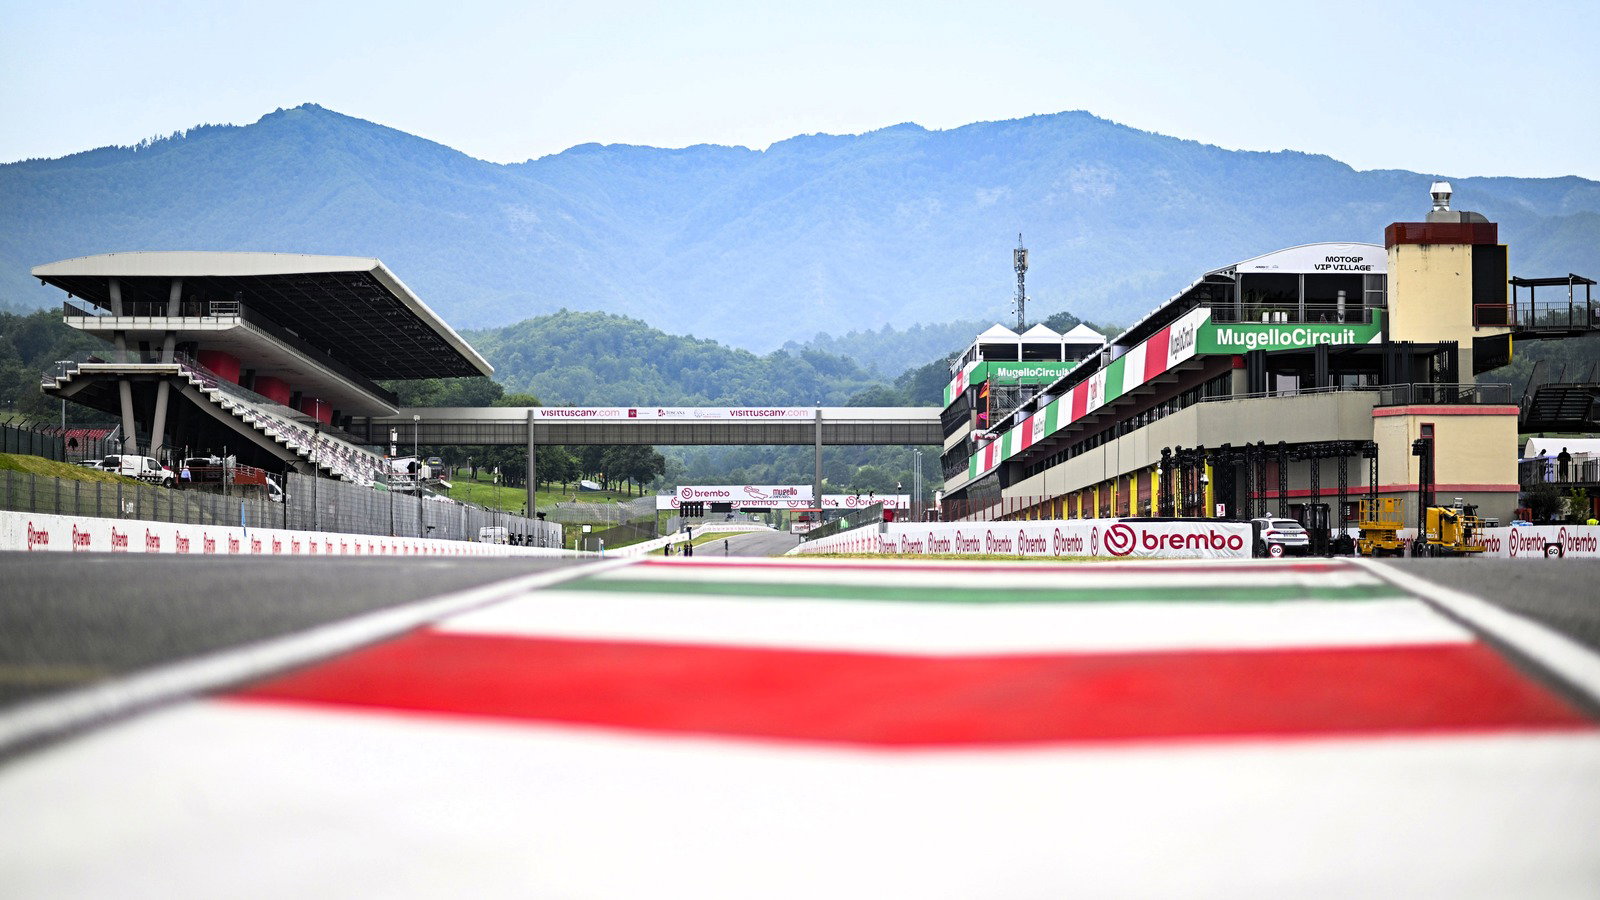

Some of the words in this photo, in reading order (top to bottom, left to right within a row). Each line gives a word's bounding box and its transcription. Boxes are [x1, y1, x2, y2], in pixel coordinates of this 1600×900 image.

[1217, 328, 1355, 349] MugelloCircuit
[997, 368, 1068, 378] MugelloCircuit
[541, 409, 620, 417] visittuscany.com
[729, 409, 809, 417] visittuscany.com
[694, 488, 730, 497] brembo
[1142, 529, 1244, 551] brembo
[1520, 533, 1546, 552] brembo
[1567, 533, 1597, 552] brembo
